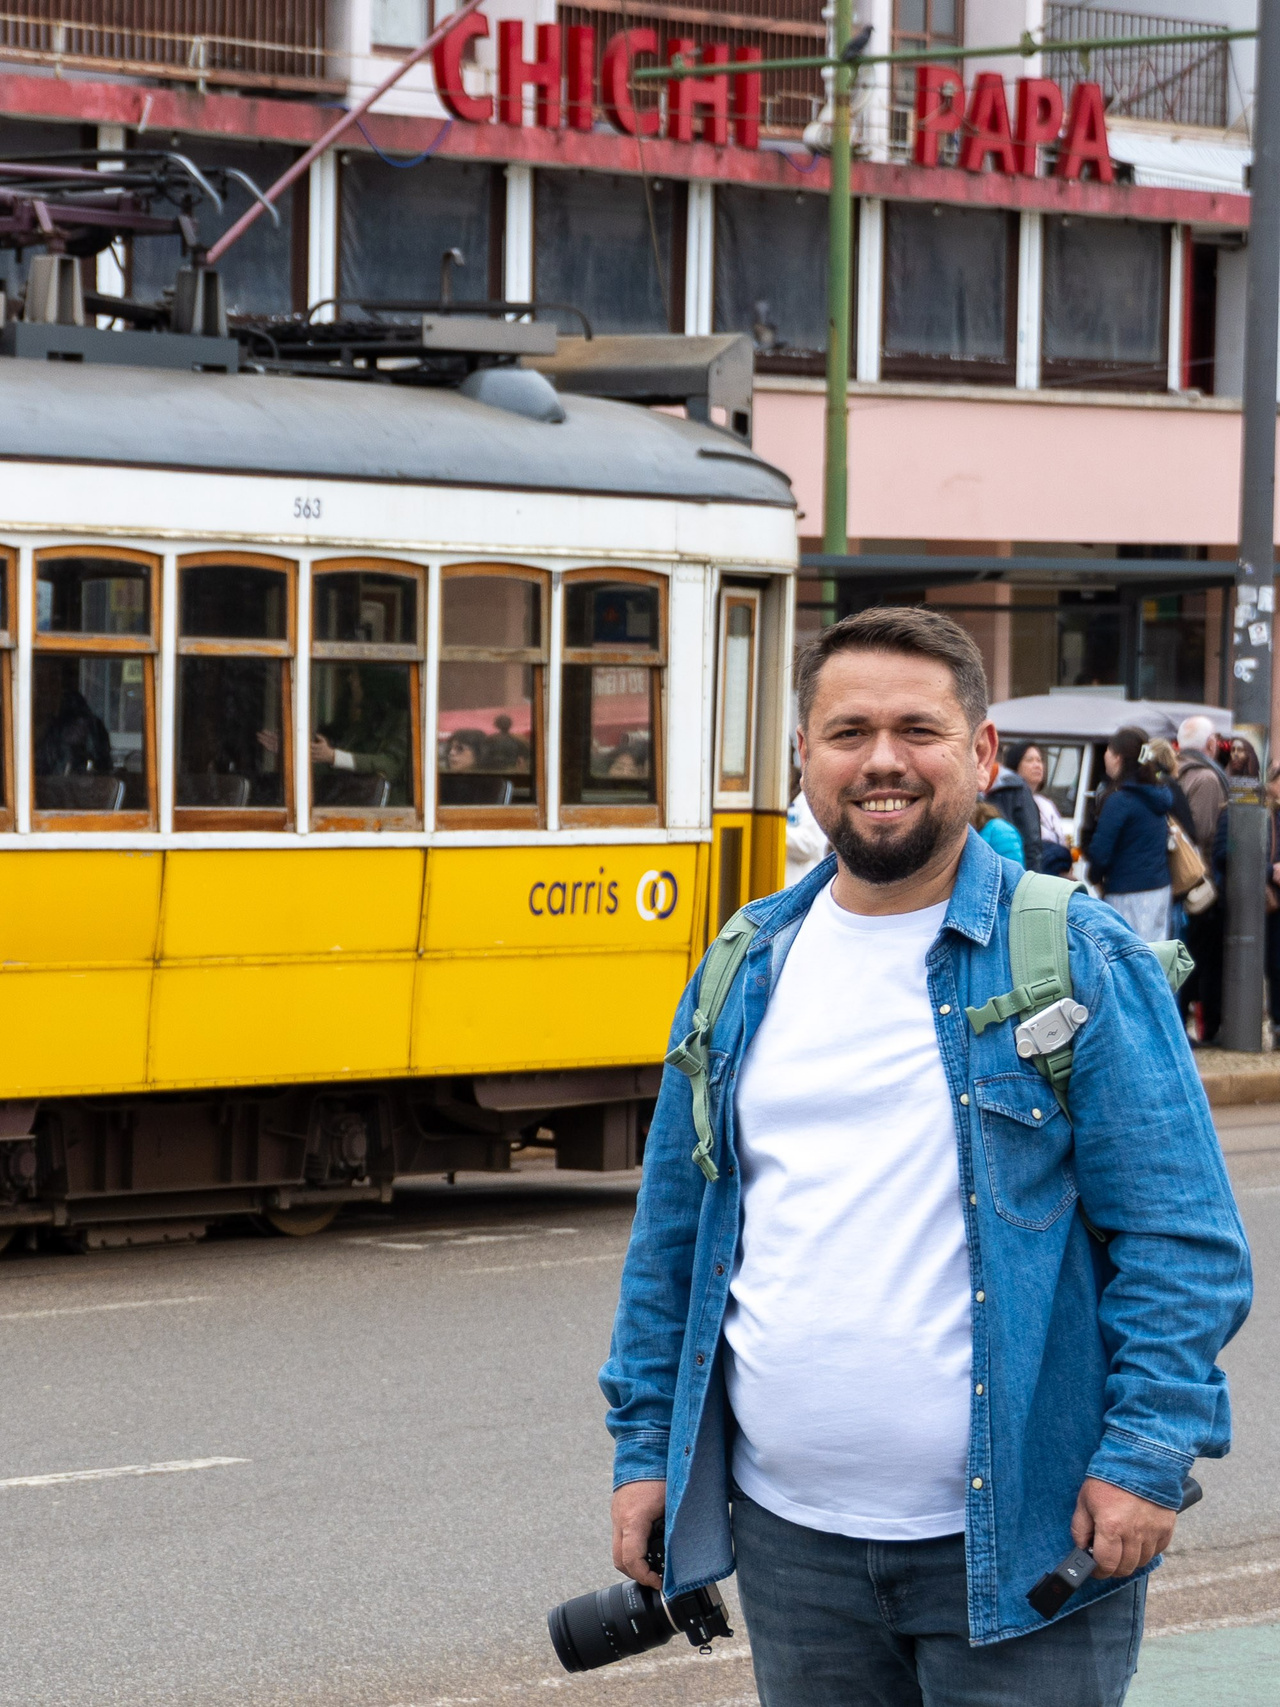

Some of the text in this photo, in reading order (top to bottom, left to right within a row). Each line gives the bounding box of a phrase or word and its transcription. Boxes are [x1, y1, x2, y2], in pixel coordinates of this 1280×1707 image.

[433, 11, 1115, 184] CHICHI PAPA
[293, 496, 321, 519] 563
[528, 866, 620, 916] carris
